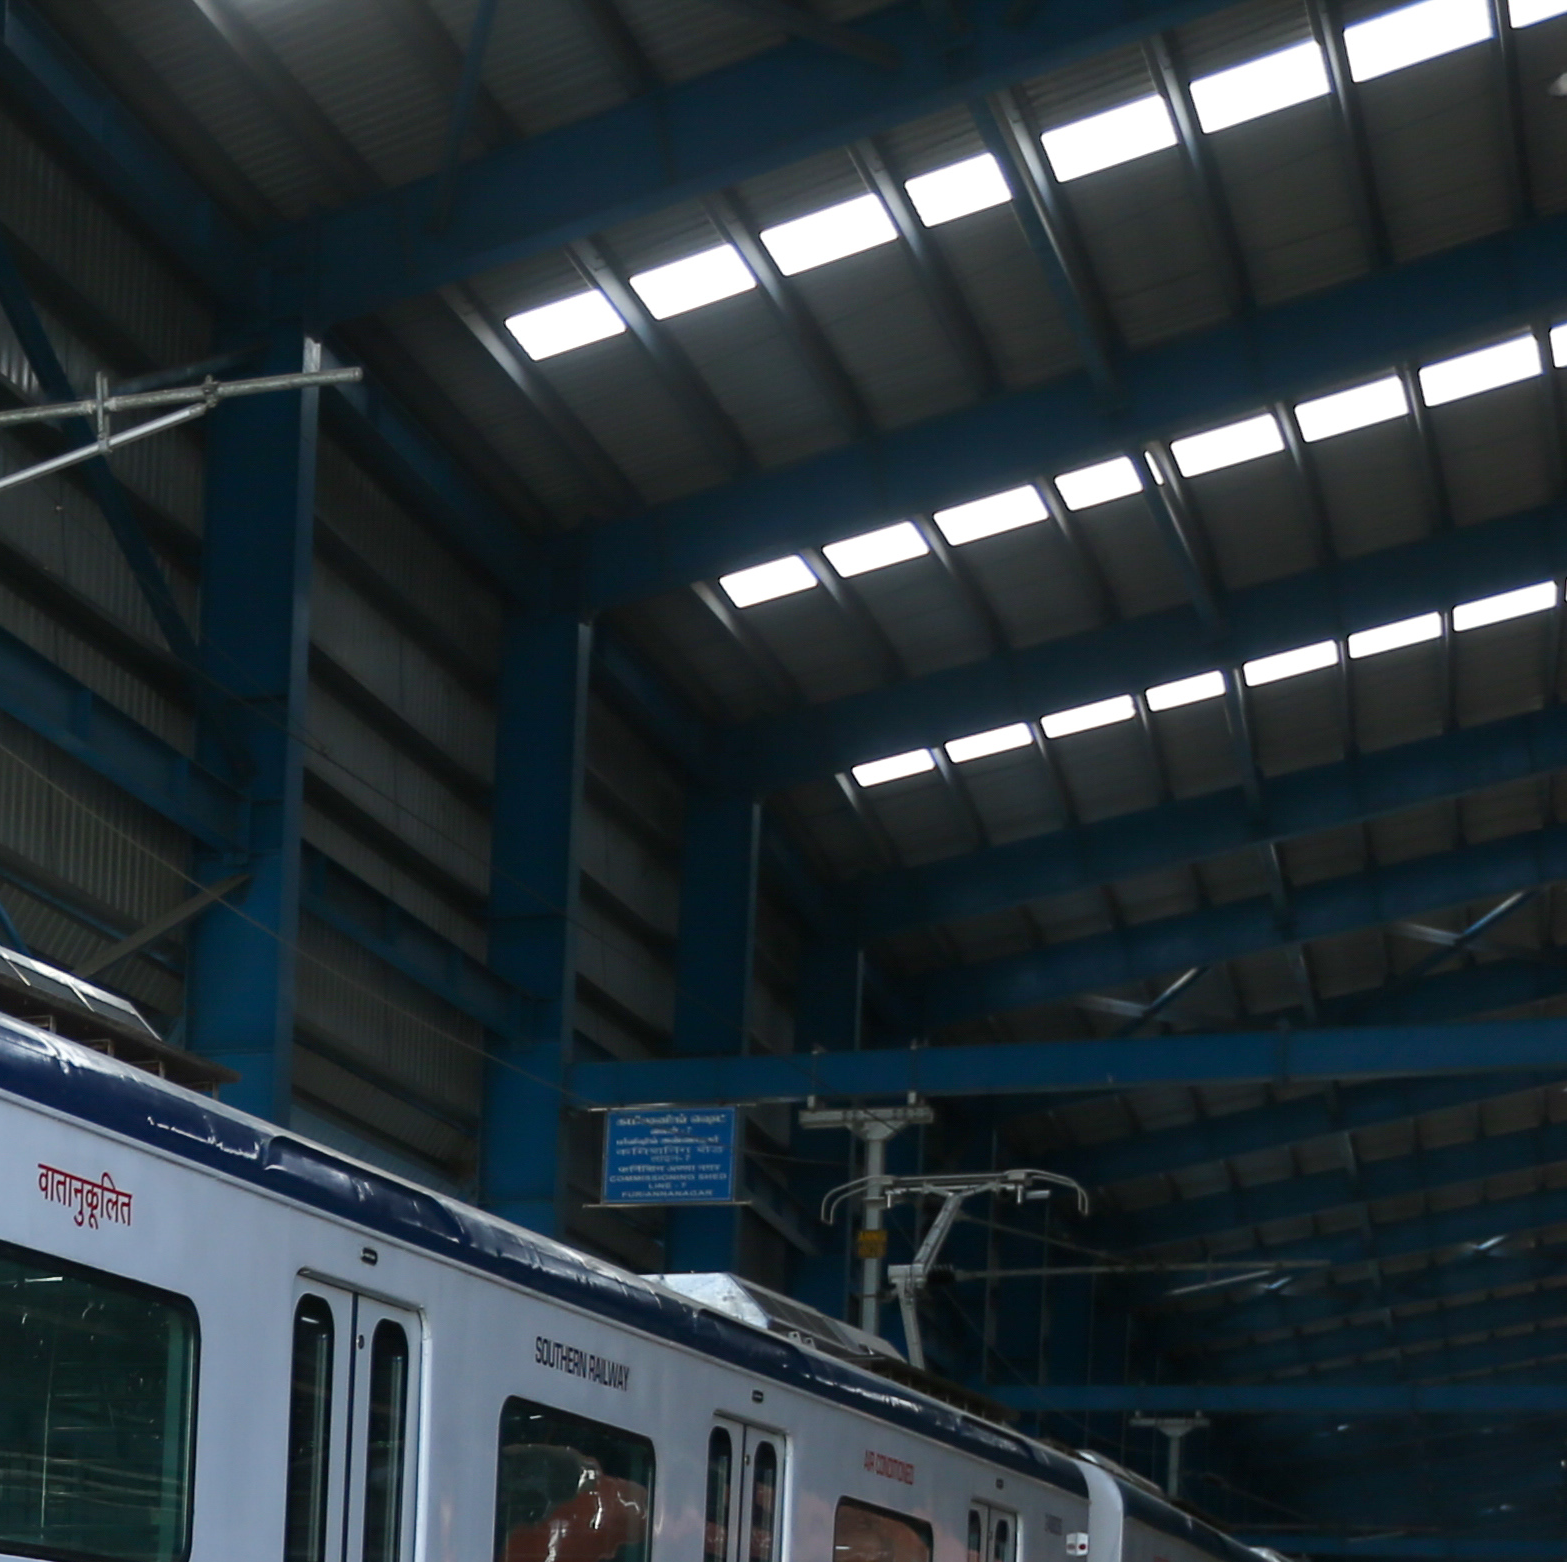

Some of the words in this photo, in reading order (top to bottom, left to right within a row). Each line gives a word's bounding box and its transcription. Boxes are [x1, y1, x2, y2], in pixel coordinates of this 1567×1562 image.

[38, 1163, 133, 1230] वातानुकूलित
[609, 1174, 695, 1183] COMMISSIONING
[698, 1172, 727, 1180] SHED
[535, 1335, 587, 1378] SOUTHERN
[588, 1354, 629, 1392] RAILWAY
[864, 1449, 875, 1471] AIR
[876, 1453, 915, 1486] CONDITIONED
